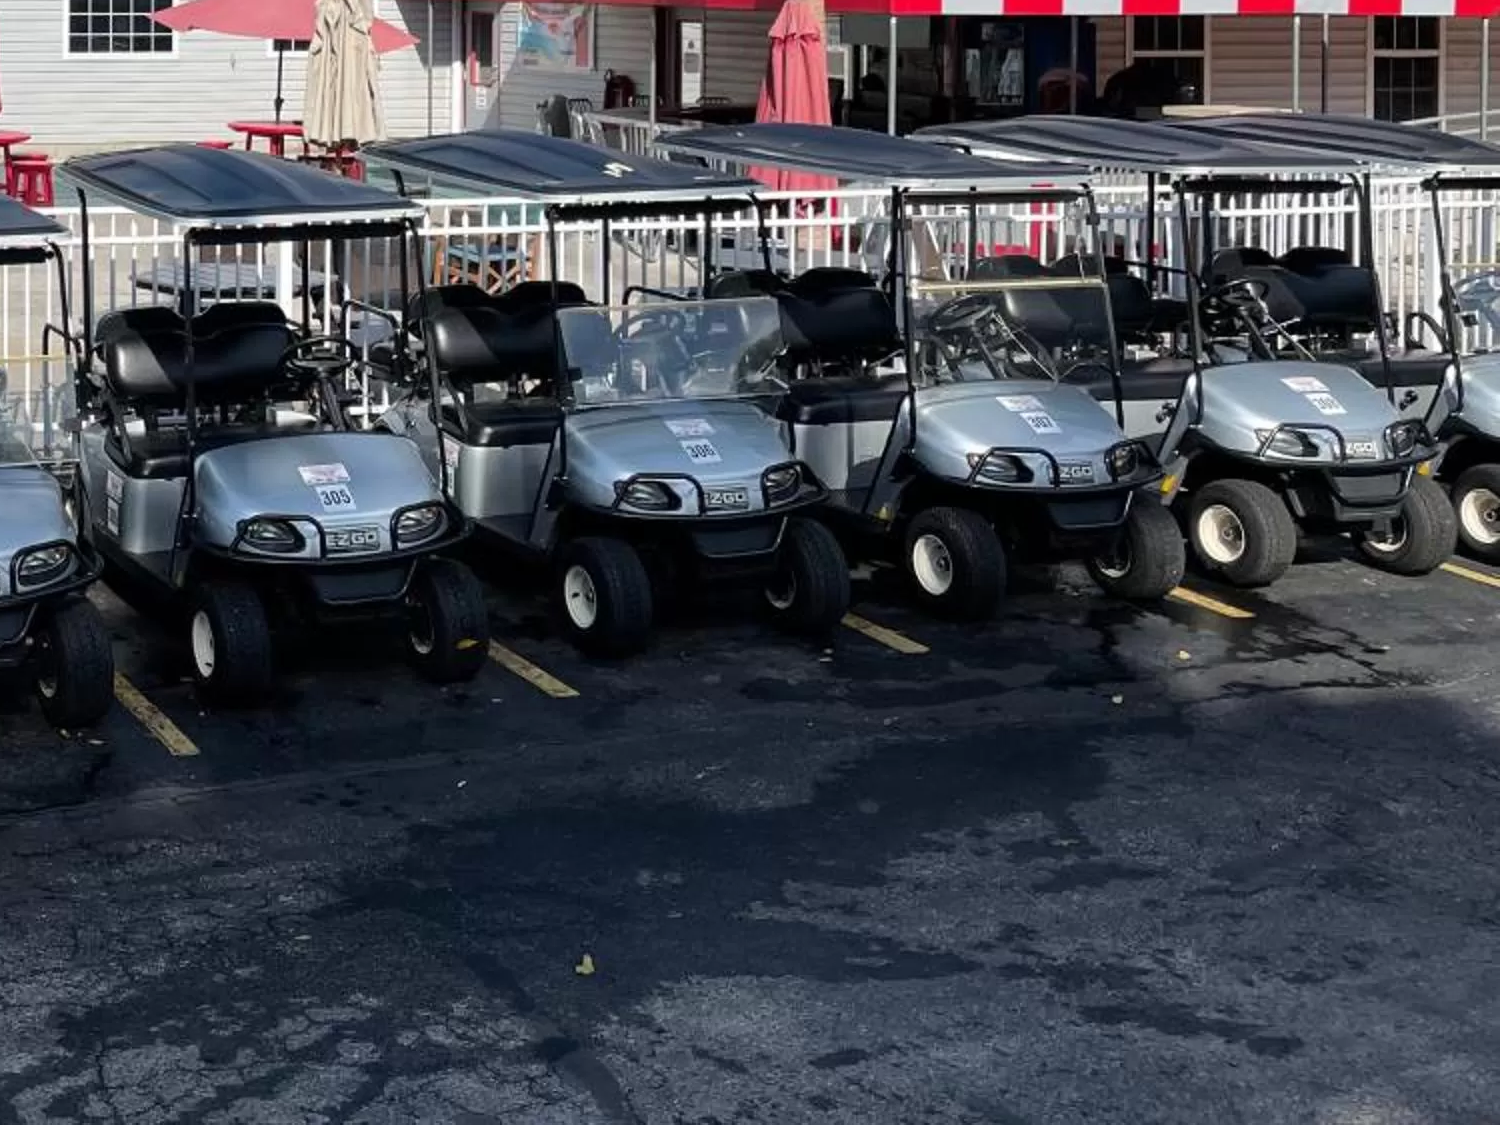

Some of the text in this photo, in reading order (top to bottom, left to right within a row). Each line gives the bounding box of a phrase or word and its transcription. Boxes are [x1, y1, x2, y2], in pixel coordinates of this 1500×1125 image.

[1026, 416, 1054, 428] 307
[1345, 442, 1374, 453] ZGO
[1058, 466, 1092, 478] ZGO
[321, 488, 351, 506] 305
[704, 492, 744, 504] ZGO
